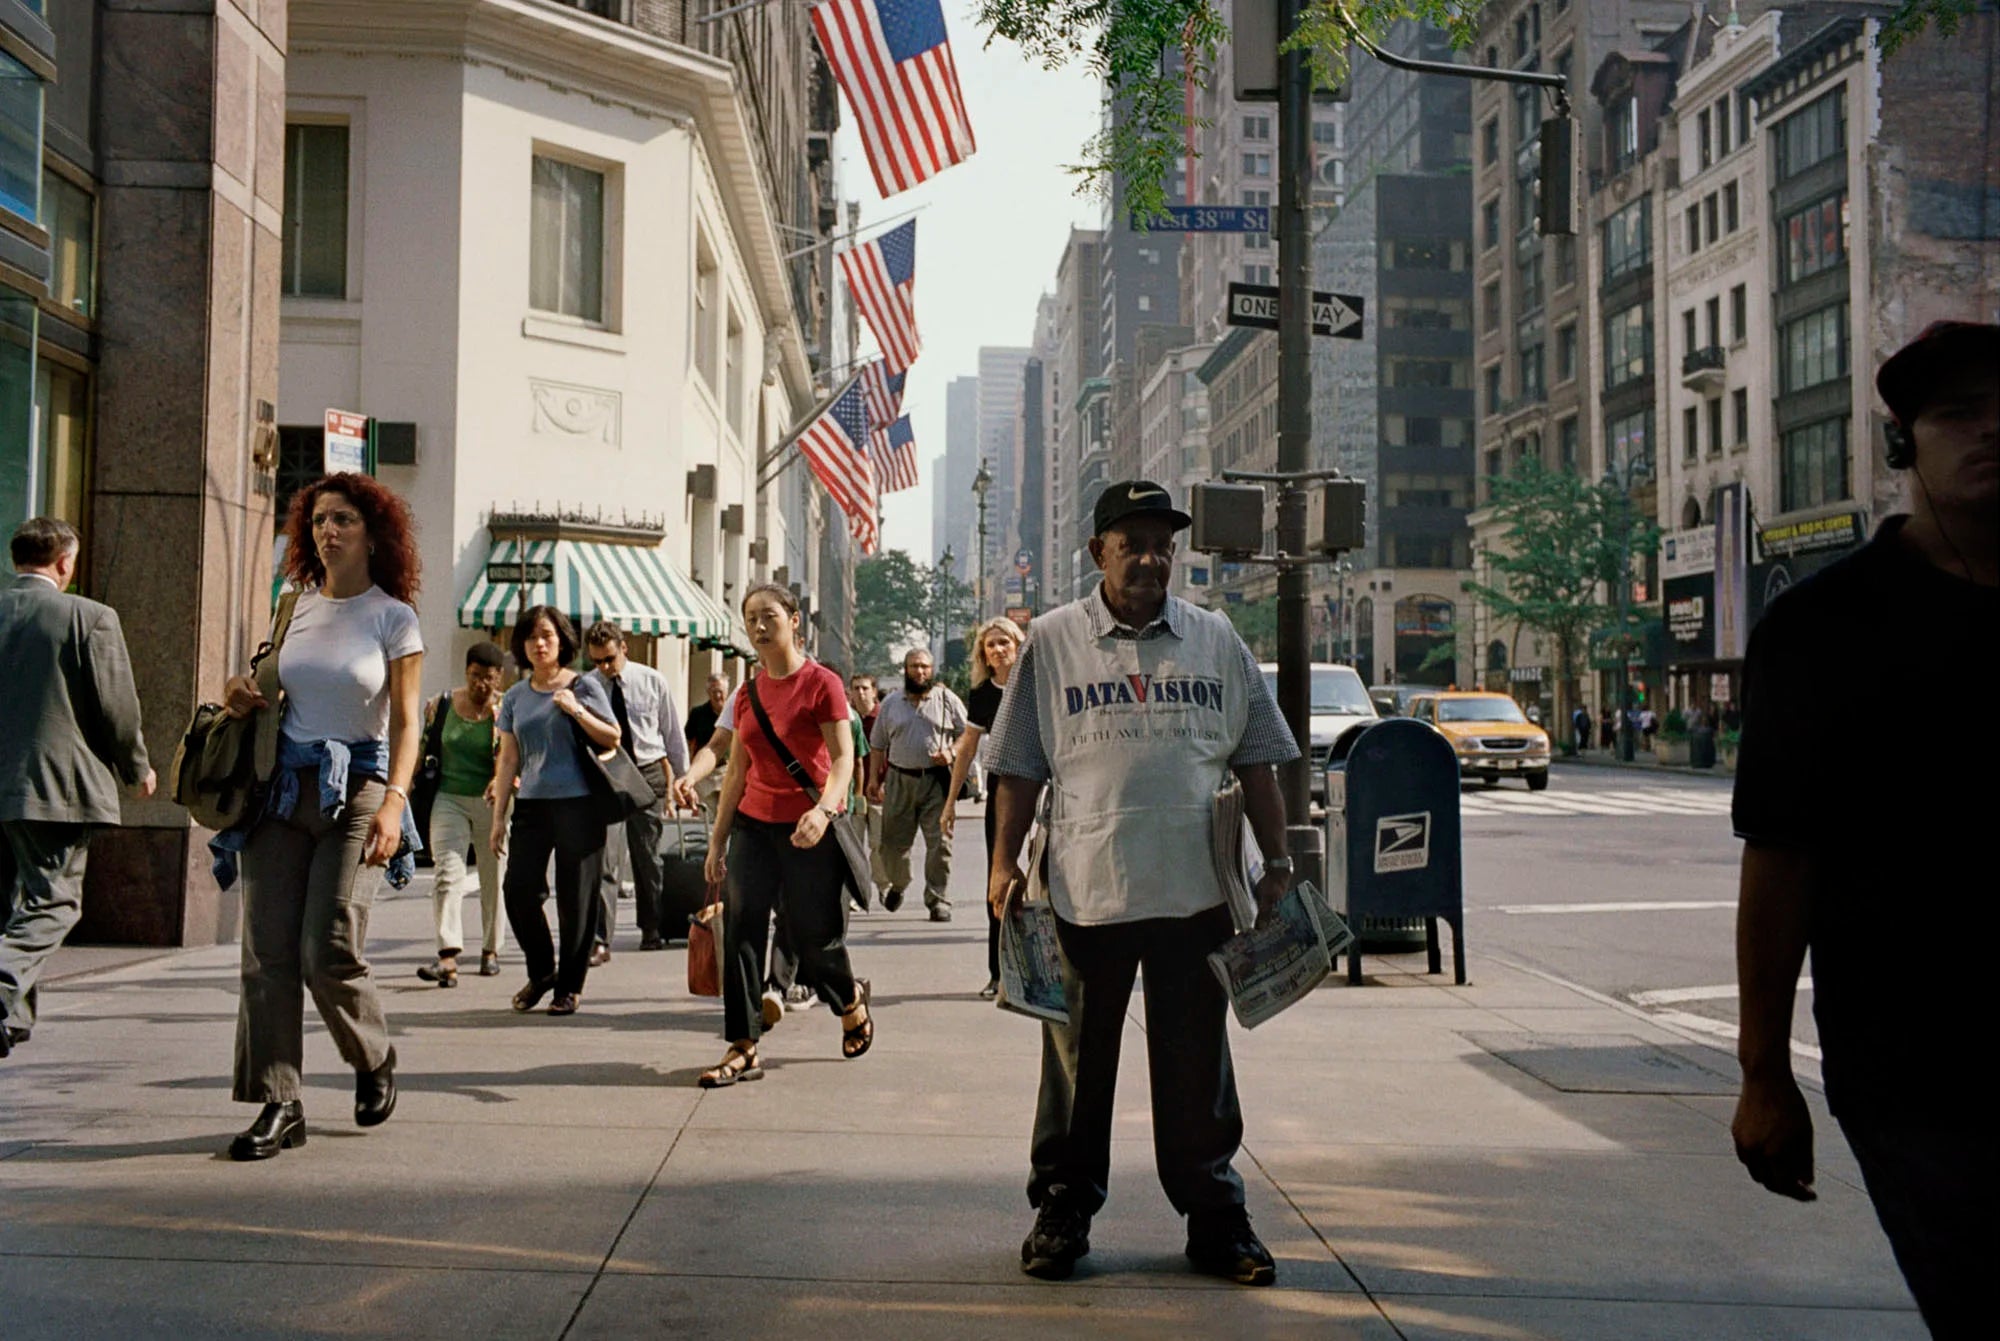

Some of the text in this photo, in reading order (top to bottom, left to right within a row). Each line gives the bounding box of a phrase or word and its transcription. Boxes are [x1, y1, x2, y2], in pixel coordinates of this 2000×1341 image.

[1243, 210, 1266, 230] St
[1240, 297, 1279, 317] ONE
[1065, 674, 1223, 716] DATAVISION
